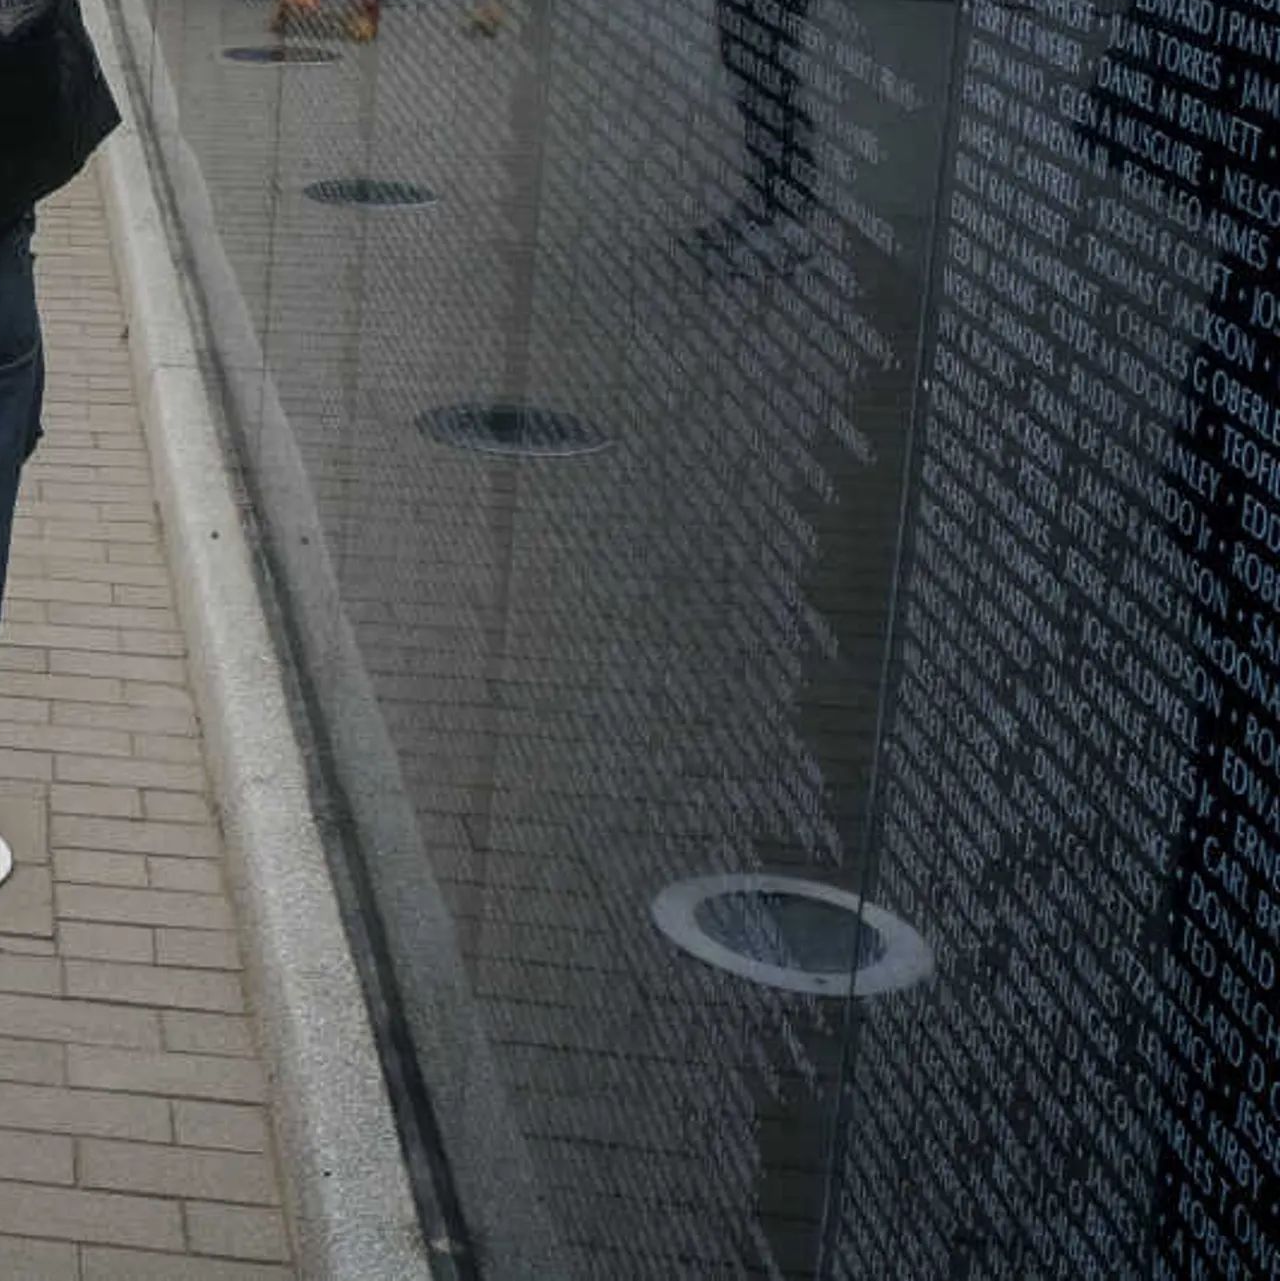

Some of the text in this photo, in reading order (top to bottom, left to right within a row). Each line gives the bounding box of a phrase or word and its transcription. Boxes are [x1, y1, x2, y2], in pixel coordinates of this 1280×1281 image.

[1108, 14, 1154, 60] JUAN
[1156, 31, 1222, 91] TORRES
[1098, 56, 1156, 113] DANIEL
[1179, 96, 1263, 161] BENNETT
[1175, 240, 1233, 301] CRAFT
[1205, 209, 1270, 271] ARMES
[1115, 305, 1192, 381] CHARLES
[1173, 297, 1256, 372] JACKSON
[1145, 421, 1222, 503] STANLEY
[1142, 516, 1230, 620] JOHNSON
